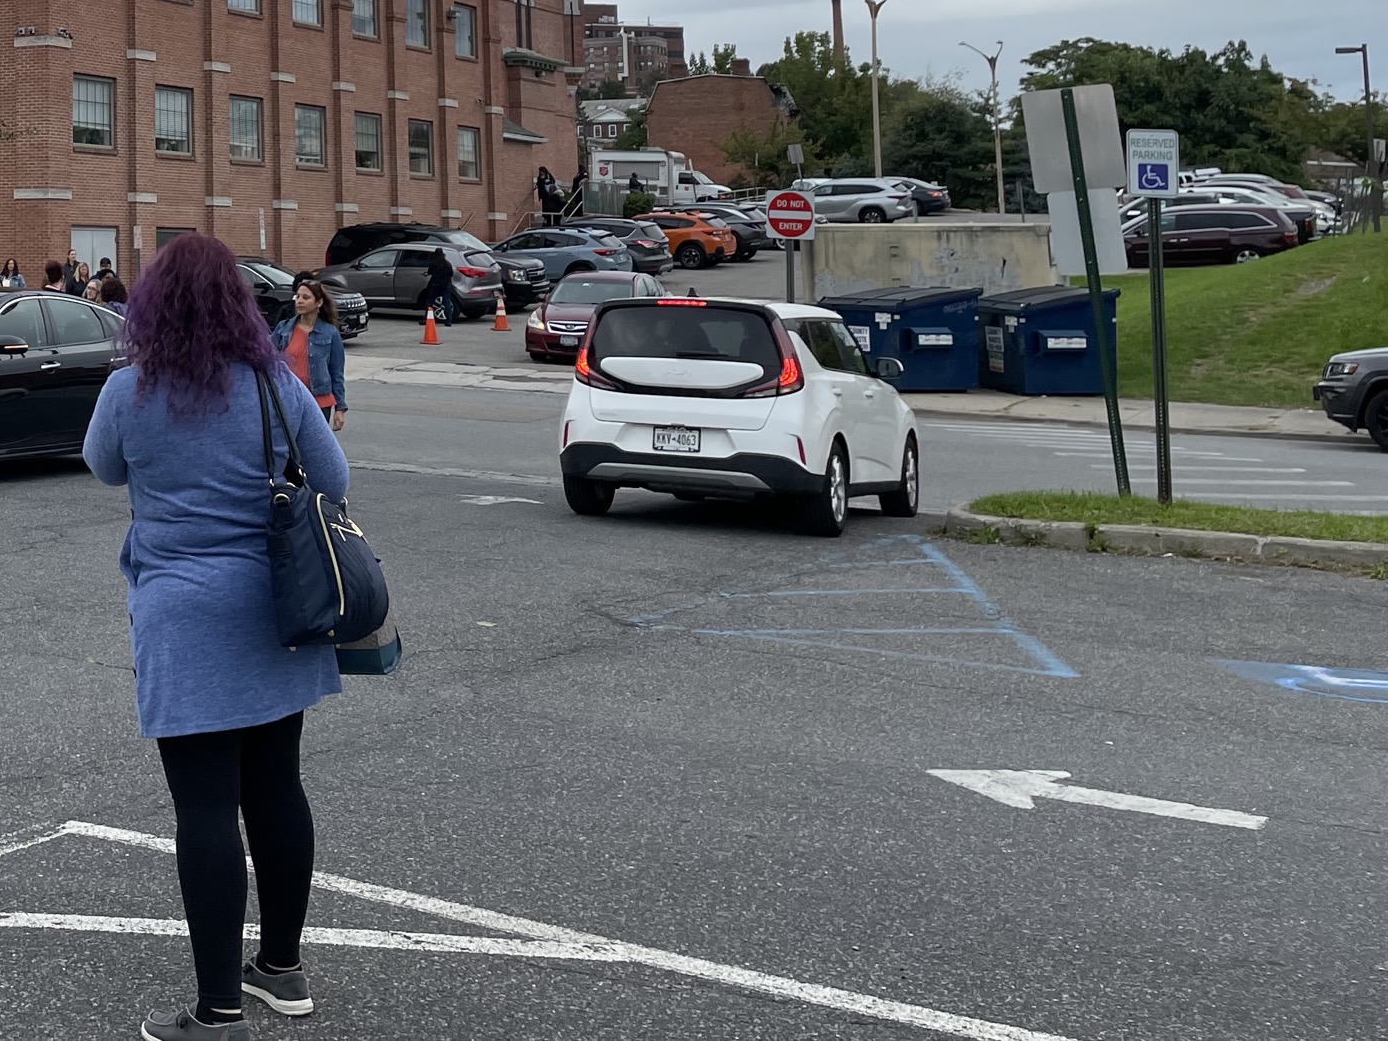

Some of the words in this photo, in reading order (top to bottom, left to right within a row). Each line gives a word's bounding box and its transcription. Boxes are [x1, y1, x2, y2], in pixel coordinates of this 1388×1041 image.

[1130, 138, 1175, 149] RESERVED
[1132, 150, 1173, 161] PARKING
[776, 199, 788, 208] DO
[790, 200, 805, 208] NOT
[779, 221, 803, 231] ENTER
